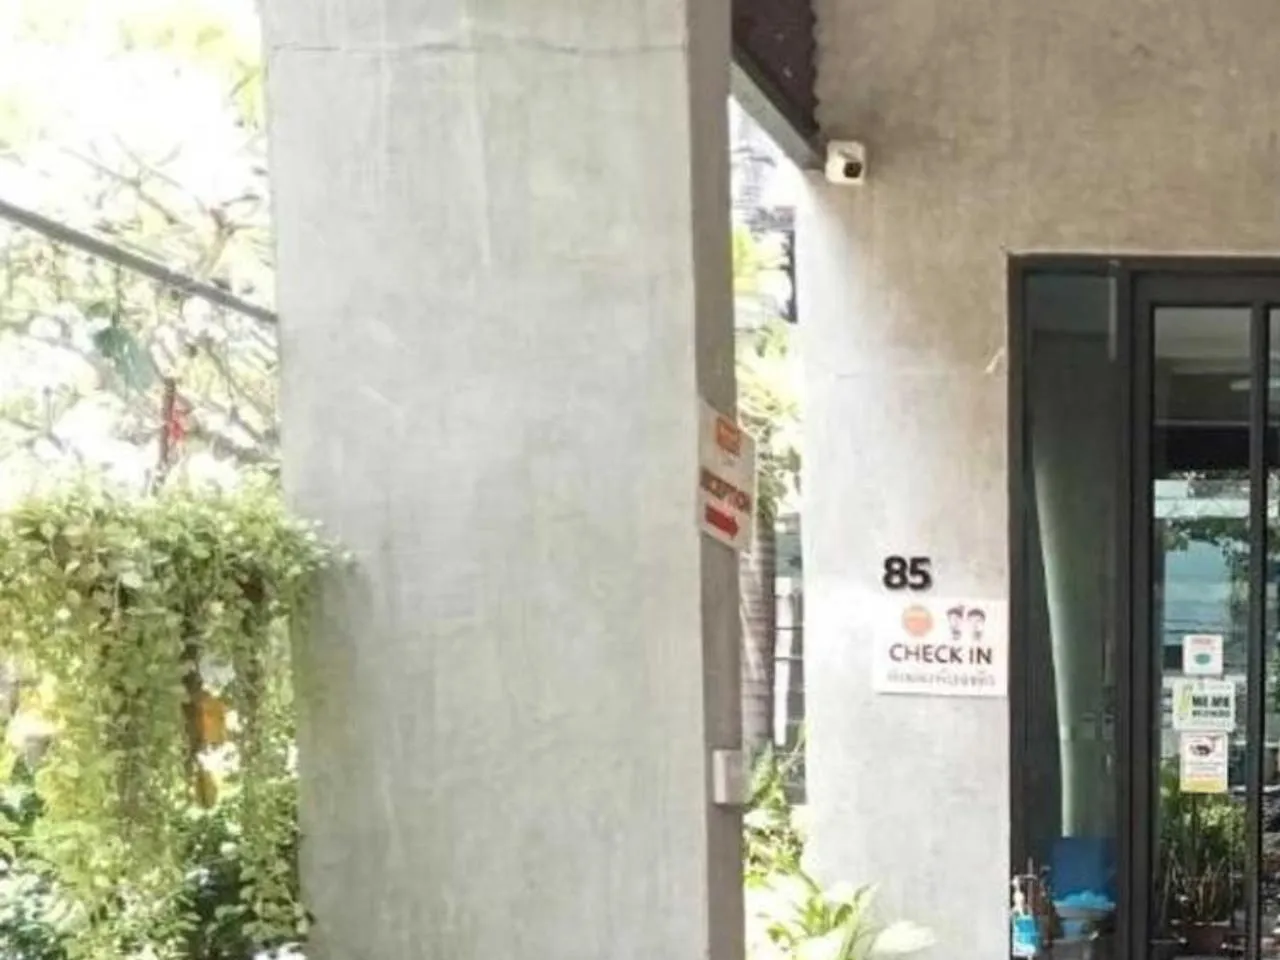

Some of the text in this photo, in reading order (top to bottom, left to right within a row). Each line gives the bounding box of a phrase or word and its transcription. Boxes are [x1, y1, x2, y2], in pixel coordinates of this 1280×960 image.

[883, 555, 932, 591] 85
[889, 643, 992, 665] CHECK IN
